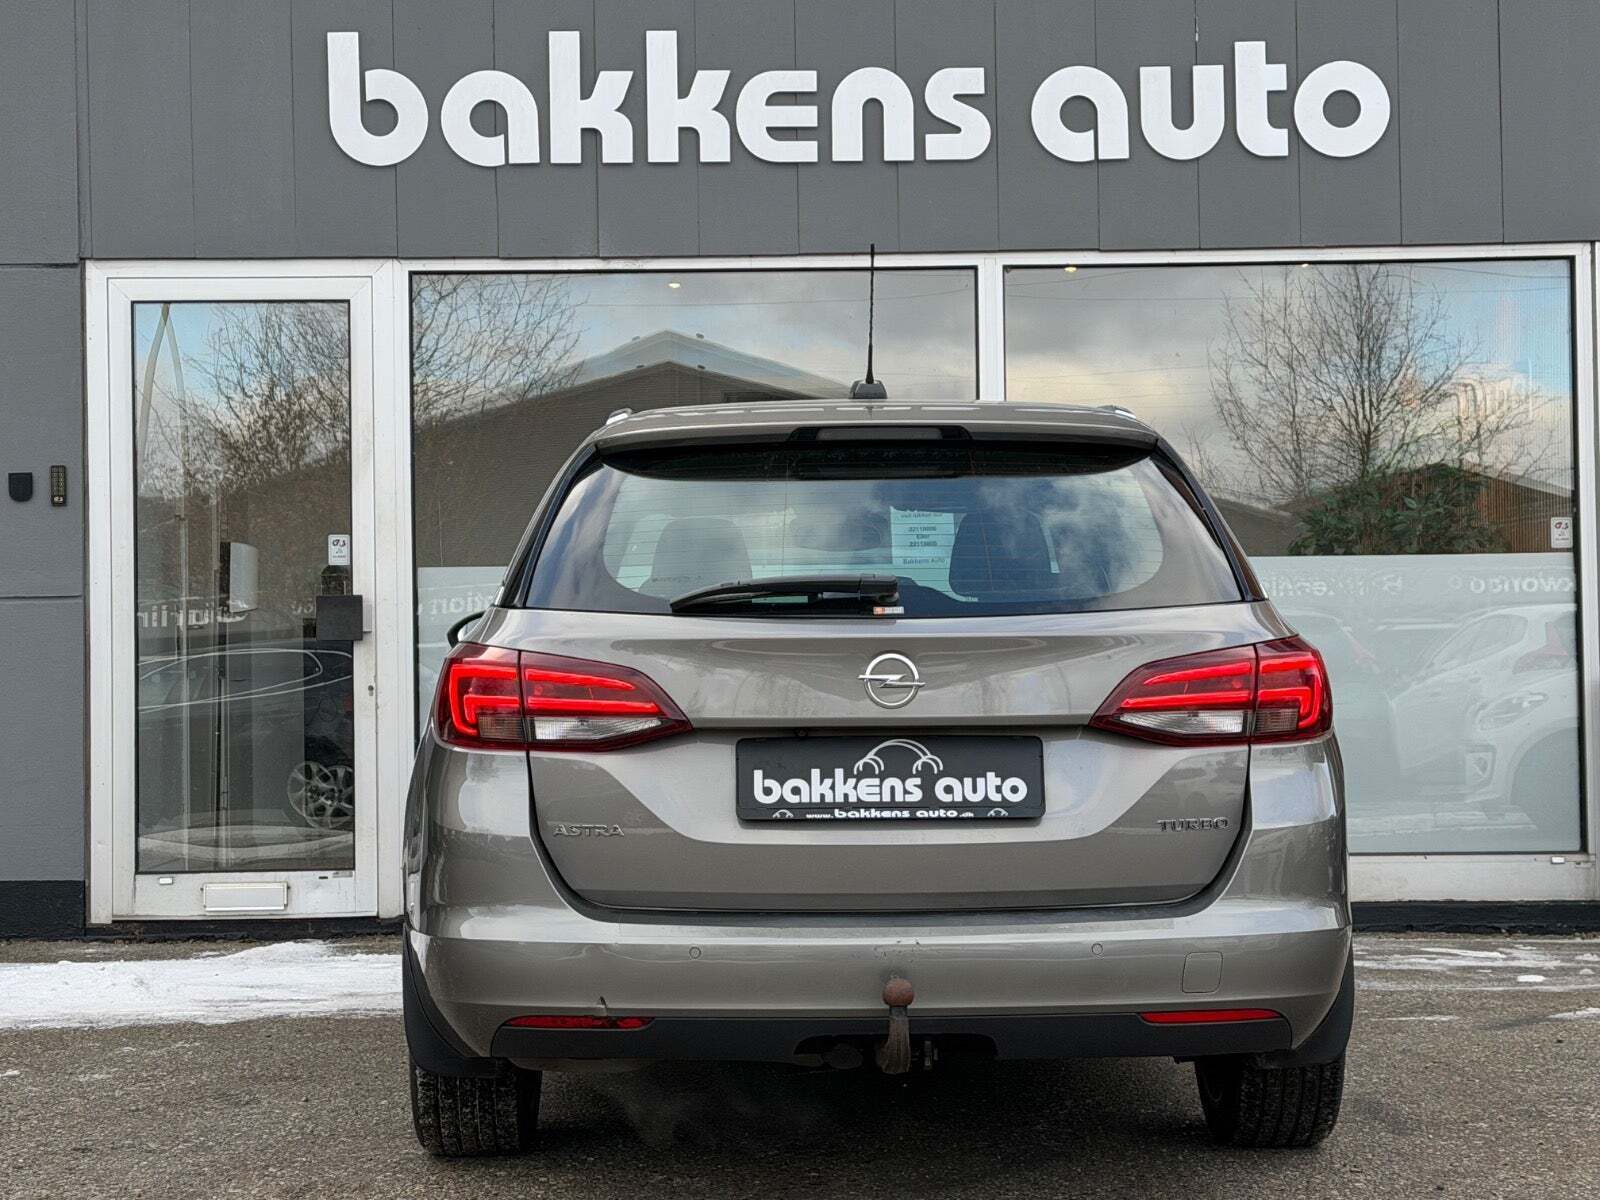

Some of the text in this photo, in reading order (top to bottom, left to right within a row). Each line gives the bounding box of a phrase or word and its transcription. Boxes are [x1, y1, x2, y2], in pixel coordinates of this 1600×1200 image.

[328, 31, 1390, 166] bakkens auto
[754, 768, 1027, 803] bakkens auto
[552, 823, 625, 838] ASTRA
[1157, 816, 1230, 832] TURBO
